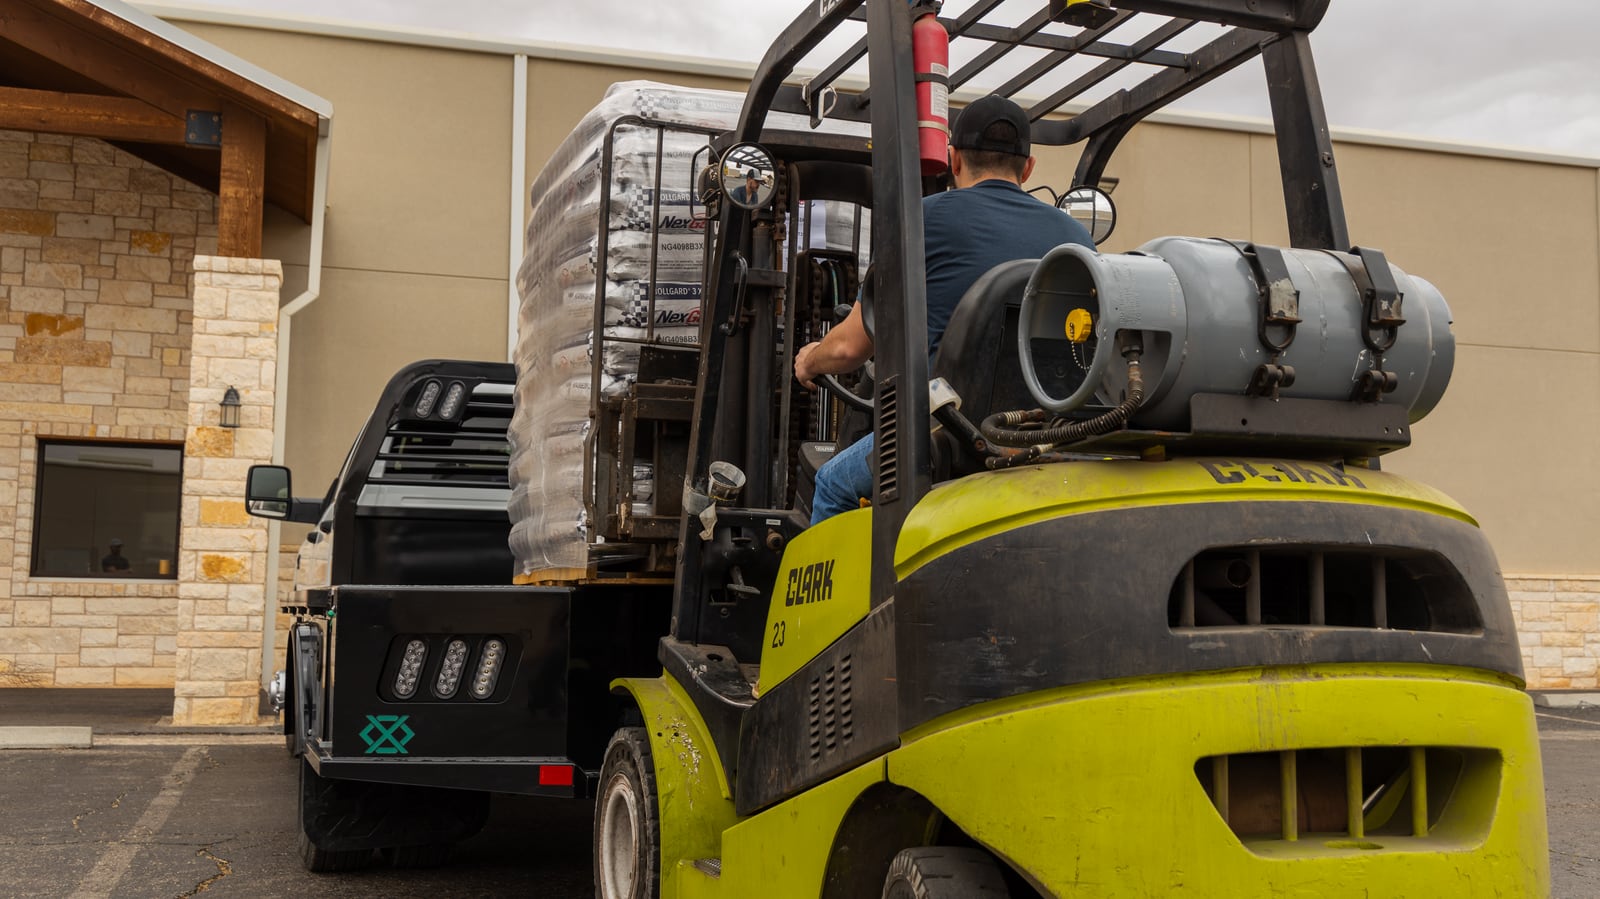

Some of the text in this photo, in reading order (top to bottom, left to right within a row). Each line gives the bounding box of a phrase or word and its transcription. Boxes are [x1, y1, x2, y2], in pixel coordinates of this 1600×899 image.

[659, 193, 690, 202] OLLGARD
[656, 287, 688, 295] OLLGARD
[785, 559, 835, 607] CLARK
[771, 620, 786, 648] 23
